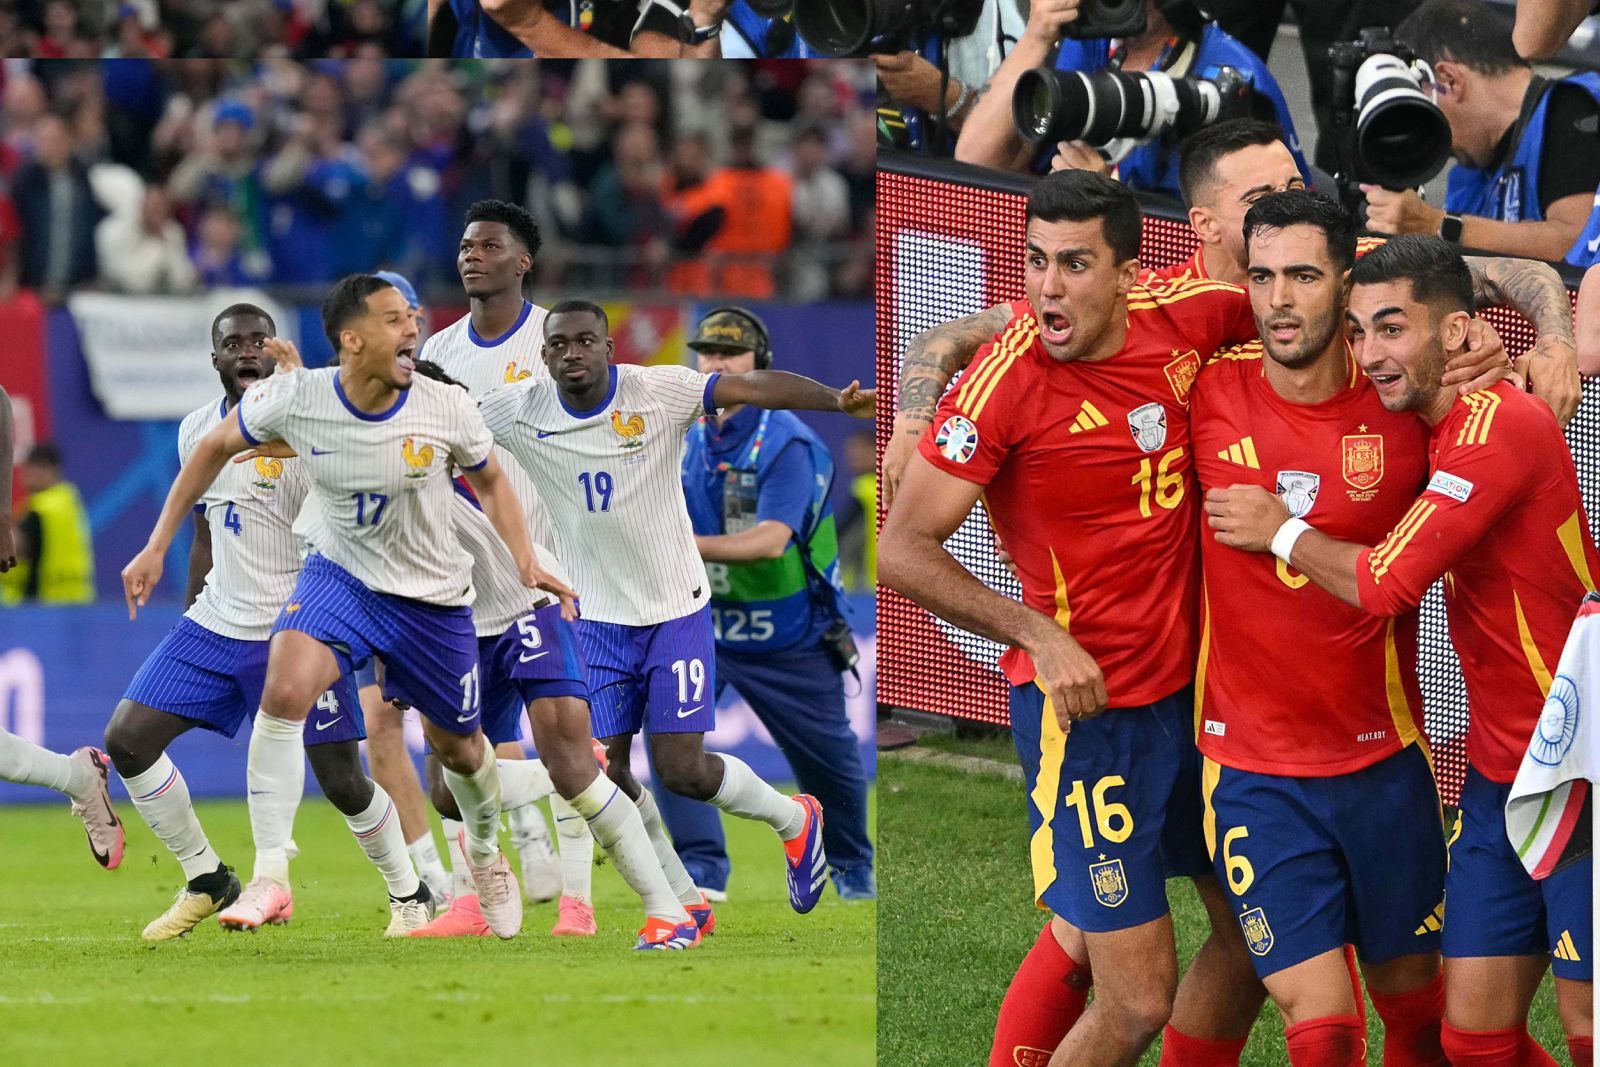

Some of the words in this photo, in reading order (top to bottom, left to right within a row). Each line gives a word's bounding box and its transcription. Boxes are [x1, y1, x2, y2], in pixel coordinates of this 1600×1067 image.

[578, 470, 614, 513] 19
[1131, 446, 1185, 518] 16
[224, 500, 243, 537] 4
[352, 491, 390, 526] 17
[516, 613, 543, 649] 5
[671, 658, 706, 703] 19
[316, 689, 340, 714] 4
[1357, 730, 1386, 742] HEAT.RDY
[1065, 775, 1134, 849] 16
[1223, 825, 1255, 896] 6
